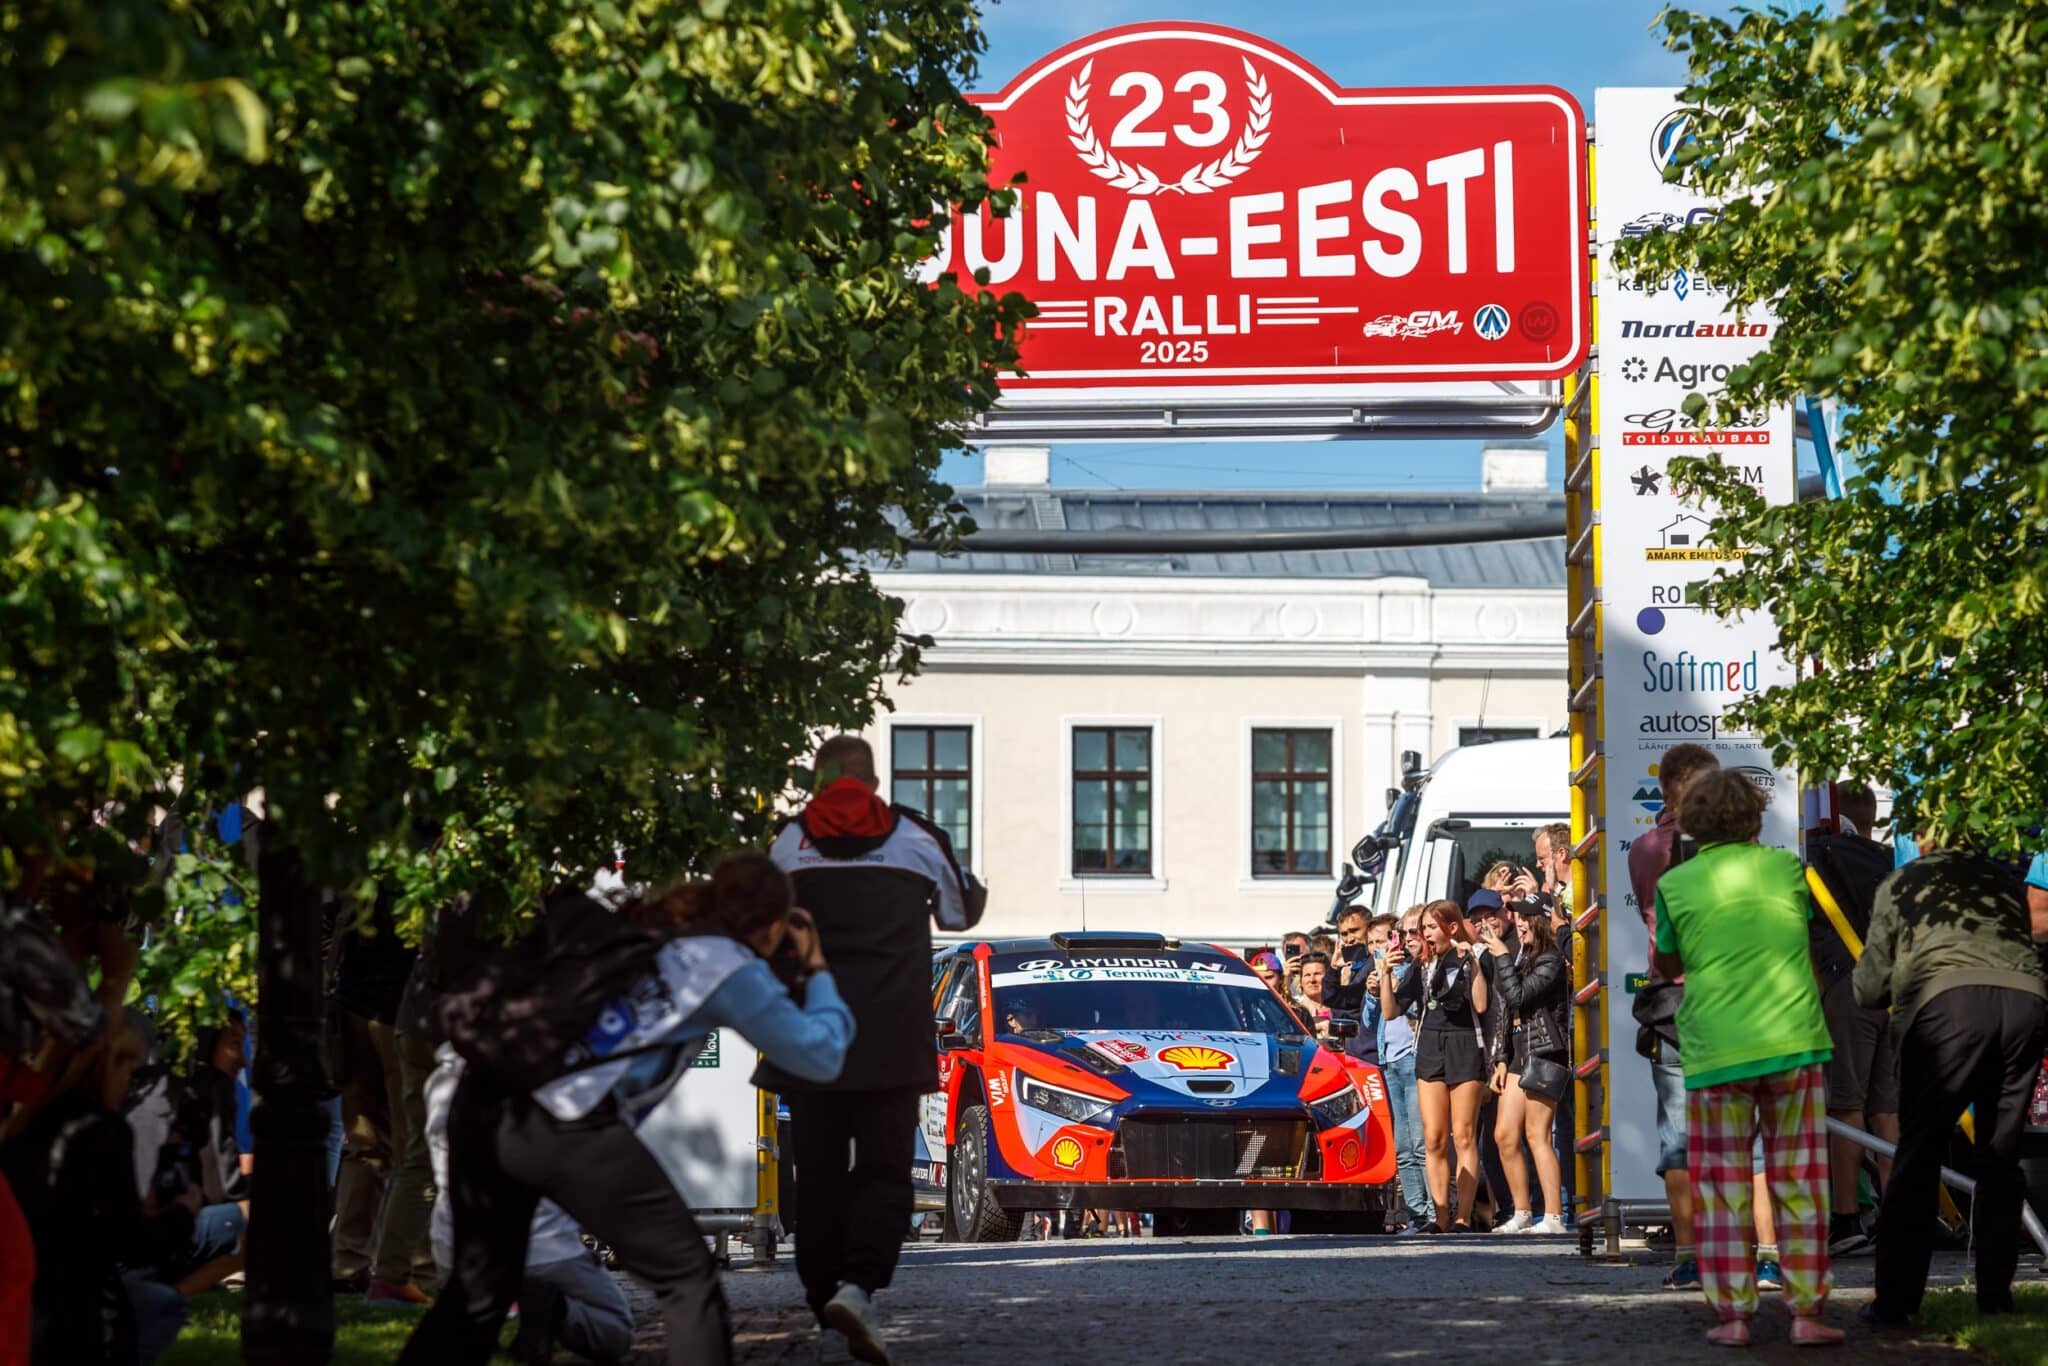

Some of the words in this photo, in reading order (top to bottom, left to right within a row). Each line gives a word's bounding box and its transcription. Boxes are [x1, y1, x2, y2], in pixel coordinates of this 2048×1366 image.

[1108, 71, 1230, 148] 23
[1095, 294, 1251, 337] RALLI
[1408, 310, 1458, 326] GM
[1621, 320, 1768, 338] Nordauto
[1140, 340, 1208, 364] 2025
[1654, 356, 1746, 390] Agro
[1624, 435, 1769, 444] TOIDUKAUBAD
[1647, 551, 1686, 560] AMARK
[1643, 650, 1757, 692] Softmed
[1070, 958, 1178, 968] HYUNDAI
[1103, 969, 1180, 979] Terminal
